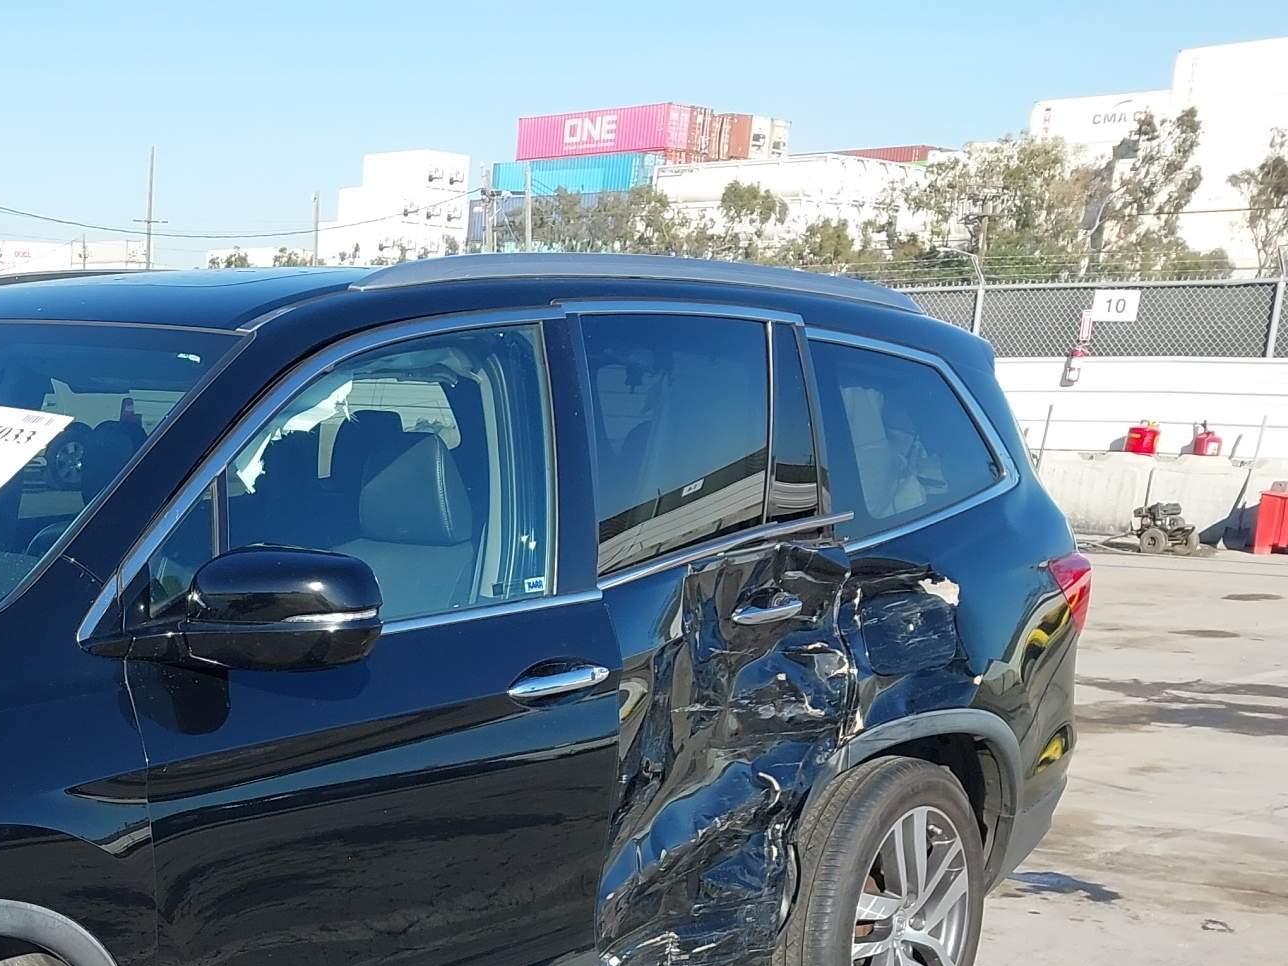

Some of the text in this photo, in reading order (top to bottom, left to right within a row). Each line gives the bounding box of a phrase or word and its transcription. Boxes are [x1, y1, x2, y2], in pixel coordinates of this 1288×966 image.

[1092, 112, 1128, 125] CMA
[563, 115, 617, 144] ONE
[1106, 298, 1127, 314] 10
